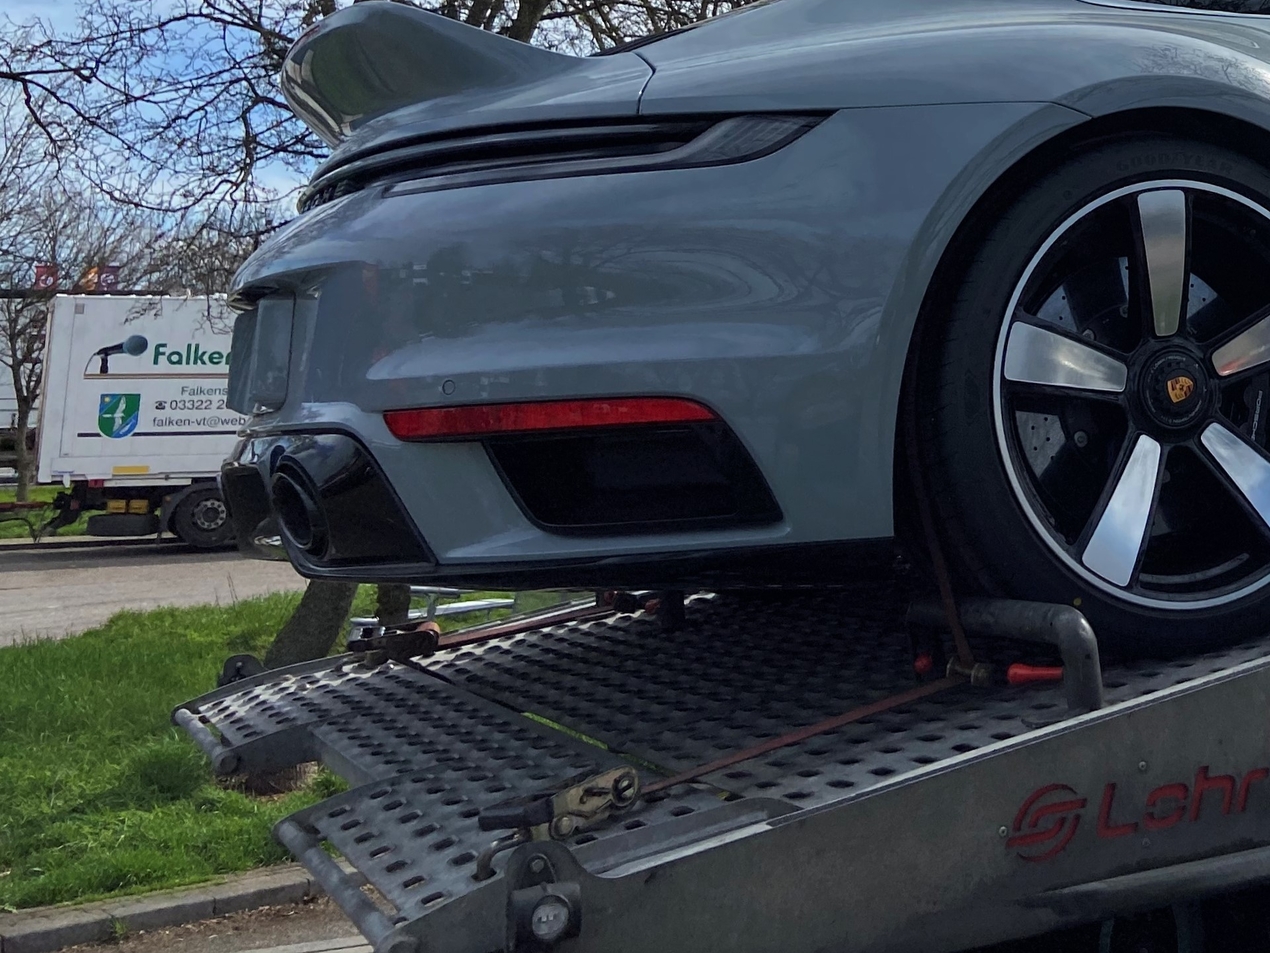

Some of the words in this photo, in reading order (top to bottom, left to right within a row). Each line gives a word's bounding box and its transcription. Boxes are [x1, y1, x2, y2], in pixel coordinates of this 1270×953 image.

[169, 399, 212, 410] 03322
[216, 399, 227, 410] 2
[1097, 765, 1270, 839] Lohr
